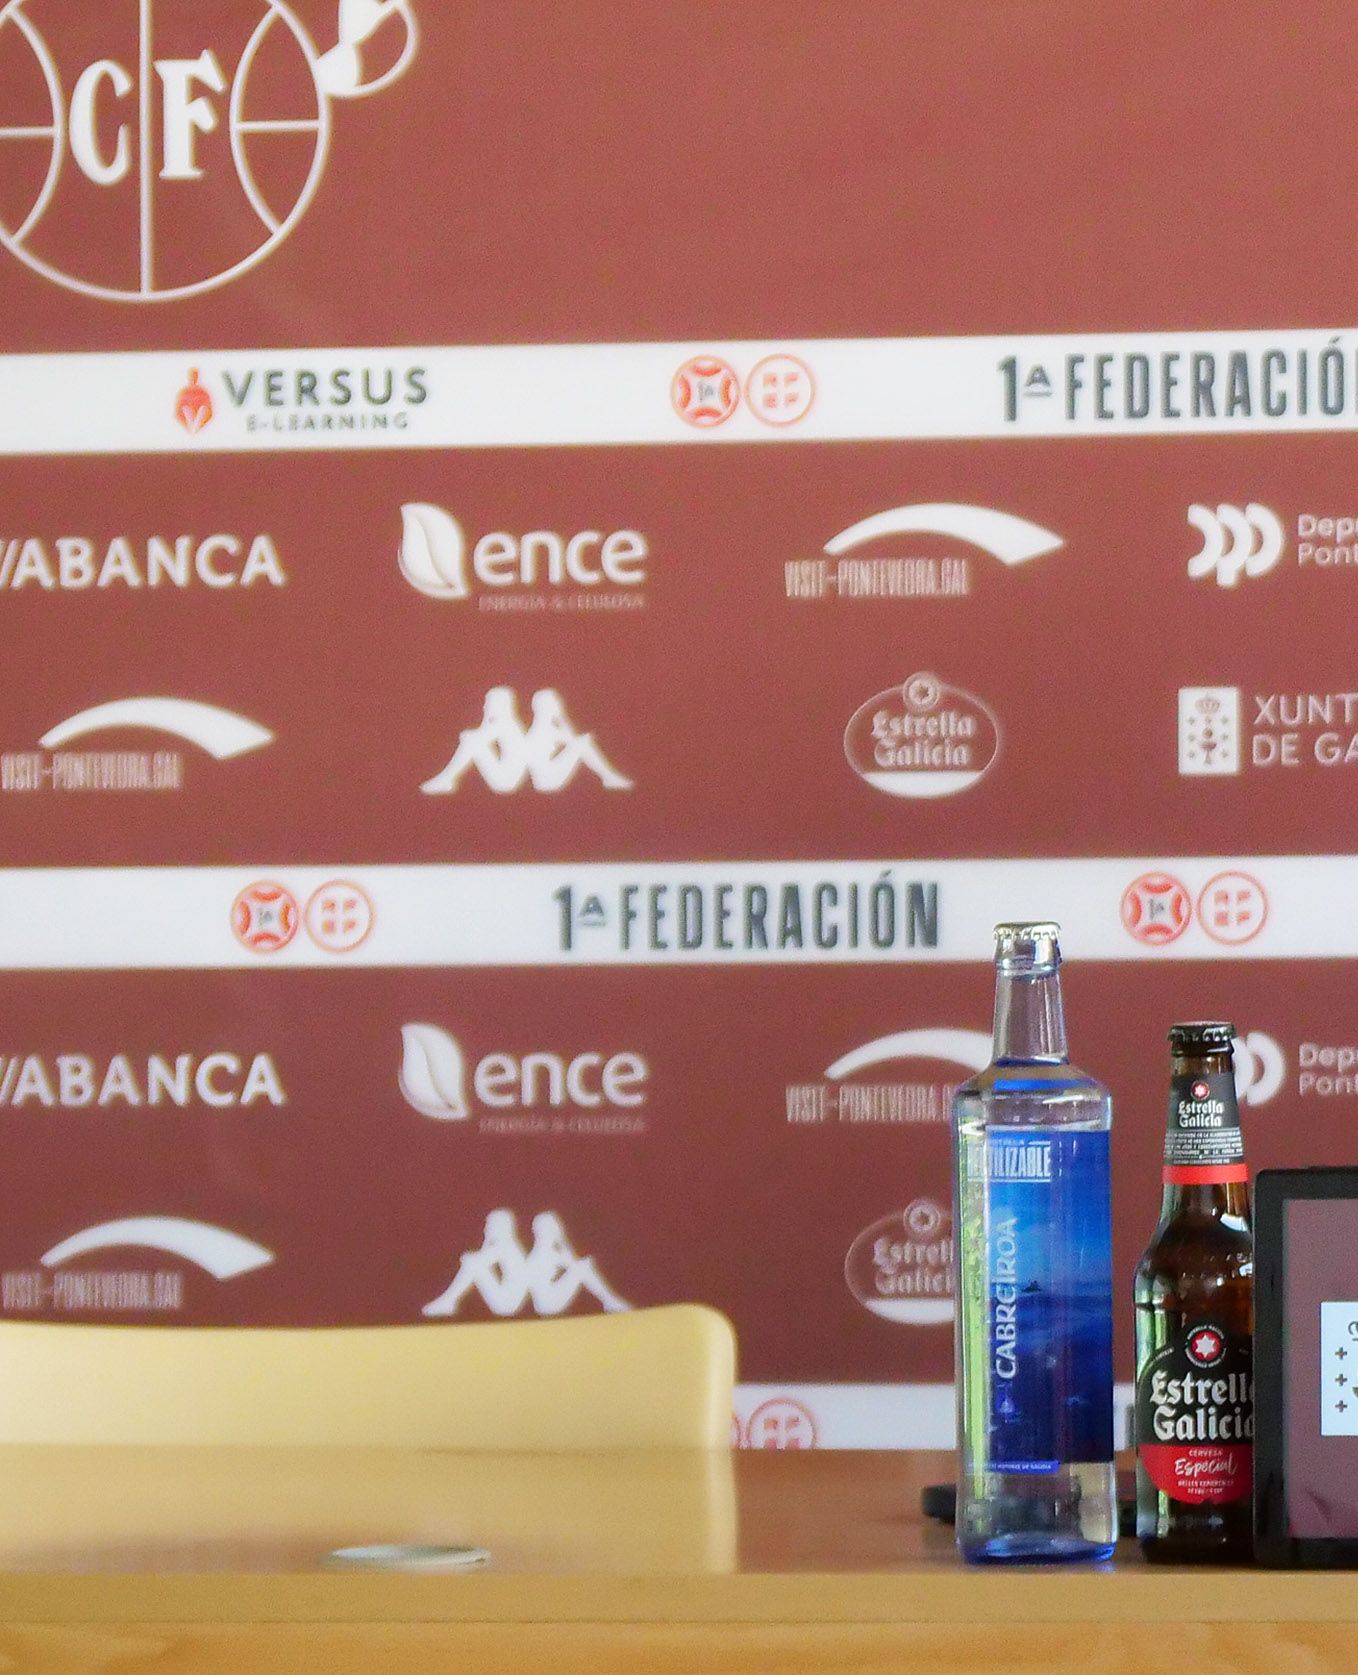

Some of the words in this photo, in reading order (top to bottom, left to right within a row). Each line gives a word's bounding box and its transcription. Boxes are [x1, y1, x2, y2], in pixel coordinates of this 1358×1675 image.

[220, 366, 428, 408] VERSUS
[245, 411, 409, 433] E-LEARNING
[473, 530, 648, 587] ence
[871, 709, 977, 740] Estrella
[874, 739, 972, 768] Galicia
[1252, 732, 1301, 766] DE
[618, 868, 940, 951] FEDERACIÓN
[473, 1051, 647, 1108] ence
[1178, 1100, 1225, 1114] Estrella
[1179, 1113, 1222, 1127] Galicia
[1150, 1368, 1254, 1405] Estrell
[1173, 1451, 1239, 1478] Especial
